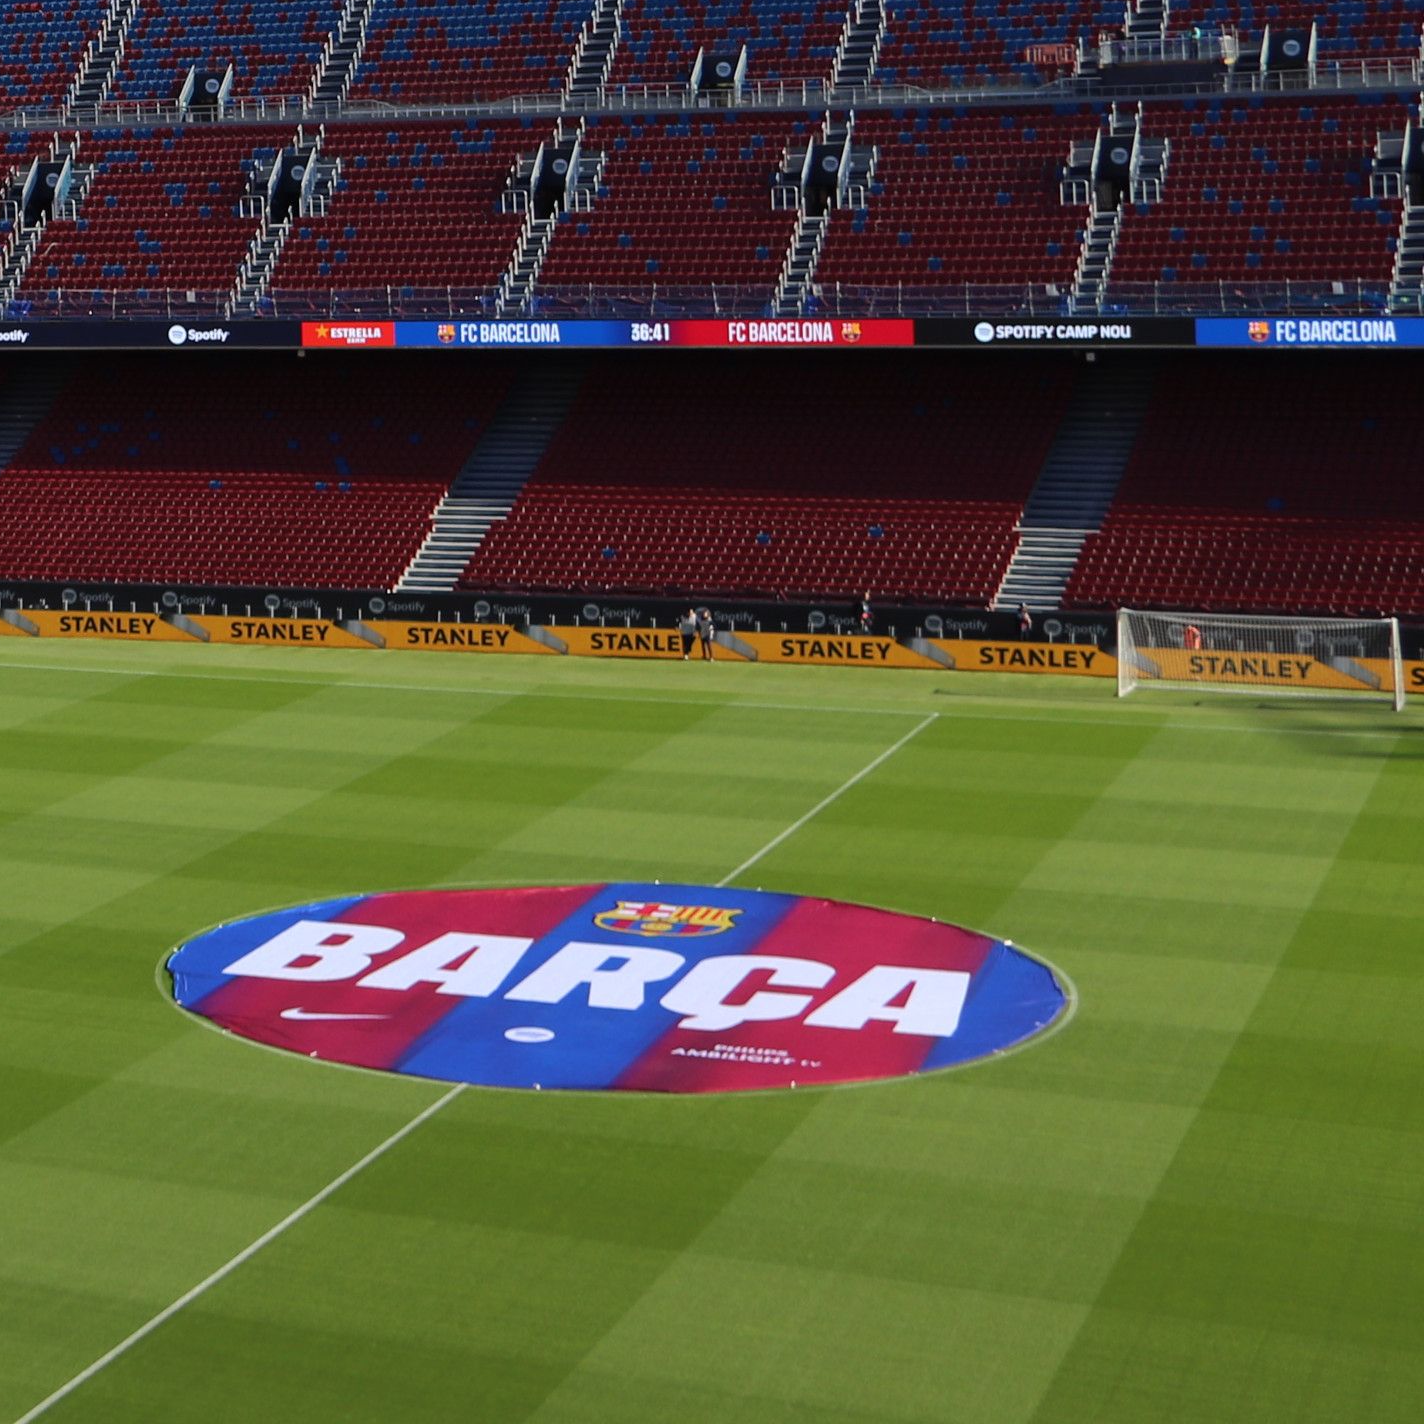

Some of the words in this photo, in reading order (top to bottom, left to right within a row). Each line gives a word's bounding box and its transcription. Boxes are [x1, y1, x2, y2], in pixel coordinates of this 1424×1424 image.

[187, 328, 229, 344] Spotify
[330, 327, 381, 338] ESTRELLA
[461, 323, 479, 343] FC
[481, 323, 560, 343] BARCELONA
[631, 323, 670, 341] 36:41
[728, 322, 746, 342] FC
[749, 322, 833, 342] BARCELONA
[995, 325, 1053, 339] SPOTIFY
[1056, 325, 1098, 339] CAMP
[1100, 325, 1131, 338] NOU
[1276, 322, 1297, 342] FC
[1299, 321, 1396, 342] BARCELONA
[59, 616, 155, 636] STANLEY
[230, 621, 330, 642] STANLEY
[407, 627, 510, 648] STANLEY
[781, 639, 892, 661] STANLEY
[979, 646, 1096, 670] STANLEY
[1189, 656, 1313, 679] STANLEY
[222, 919, 972, 1038] BARÇA
